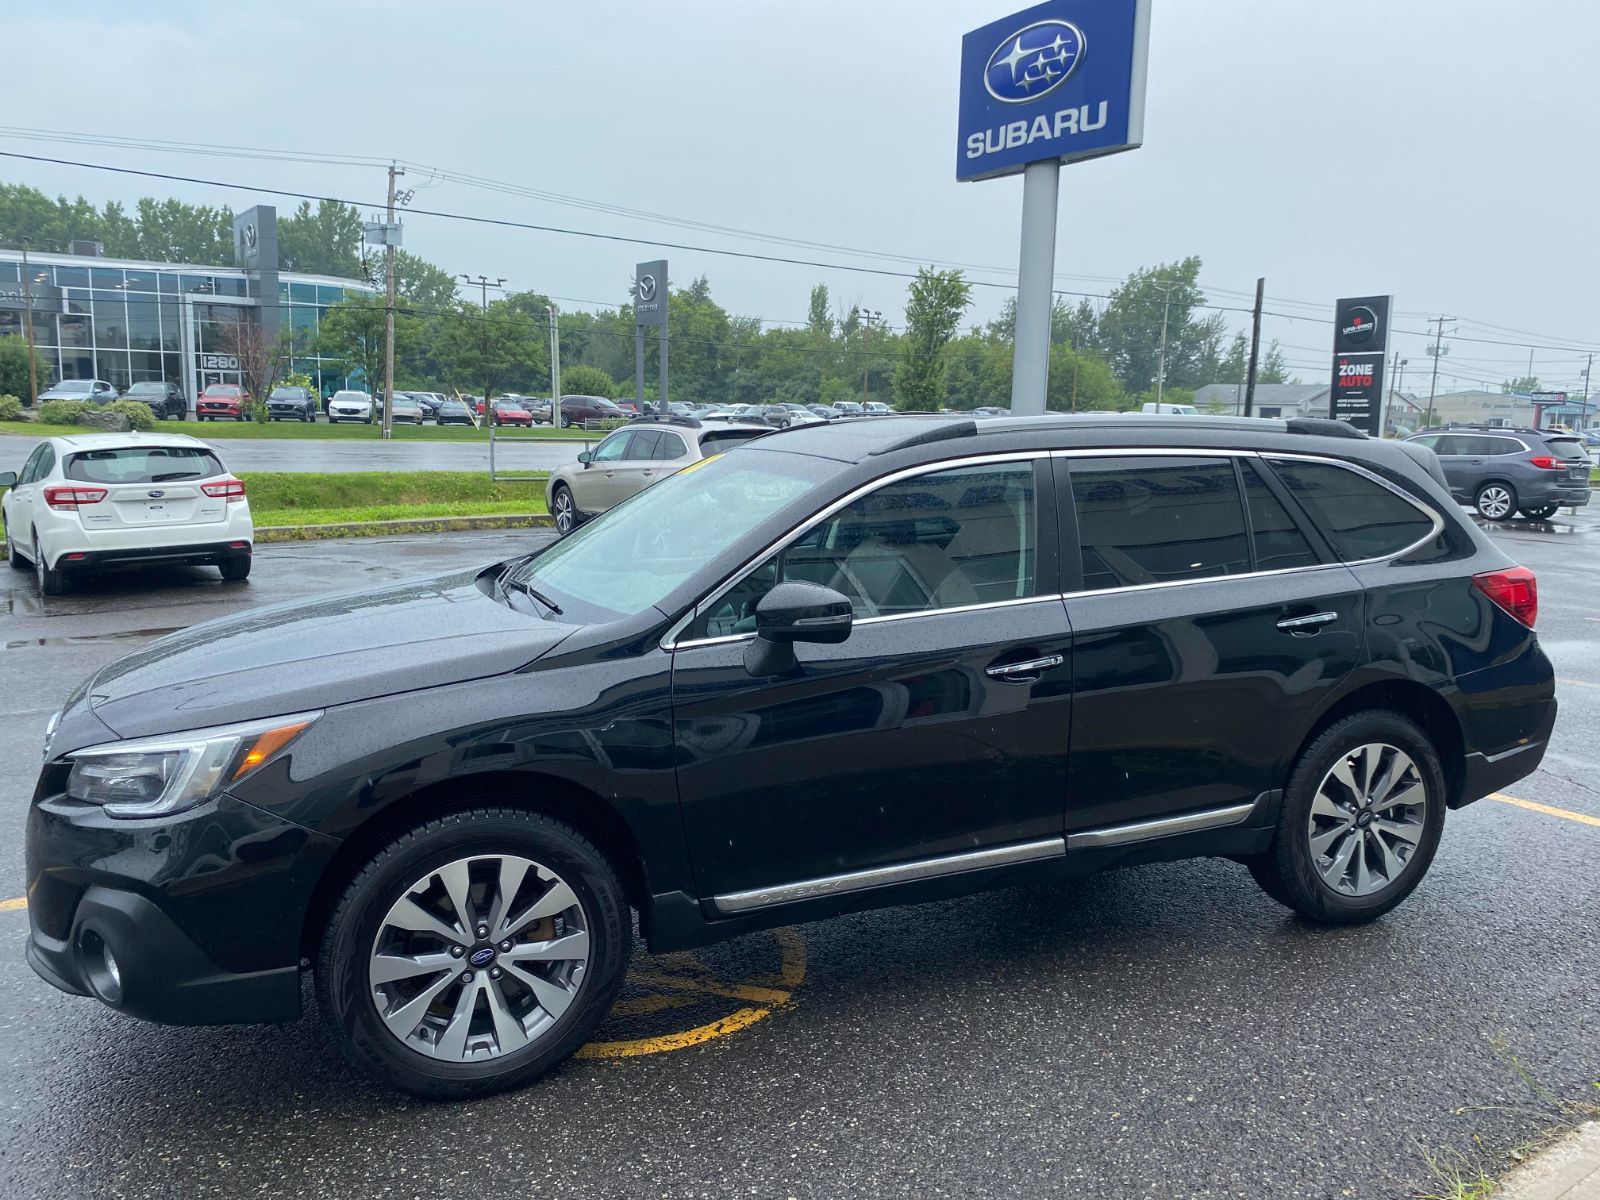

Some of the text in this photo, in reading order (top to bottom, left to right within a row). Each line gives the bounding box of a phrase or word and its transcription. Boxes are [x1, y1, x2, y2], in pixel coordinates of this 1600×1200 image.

[967, 100, 1108, 159] SUBARU
[203, 355, 239, 369] 1280
[1339, 364, 1374, 376] ZONE
[1339, 376, 1373, 387] AUTO
